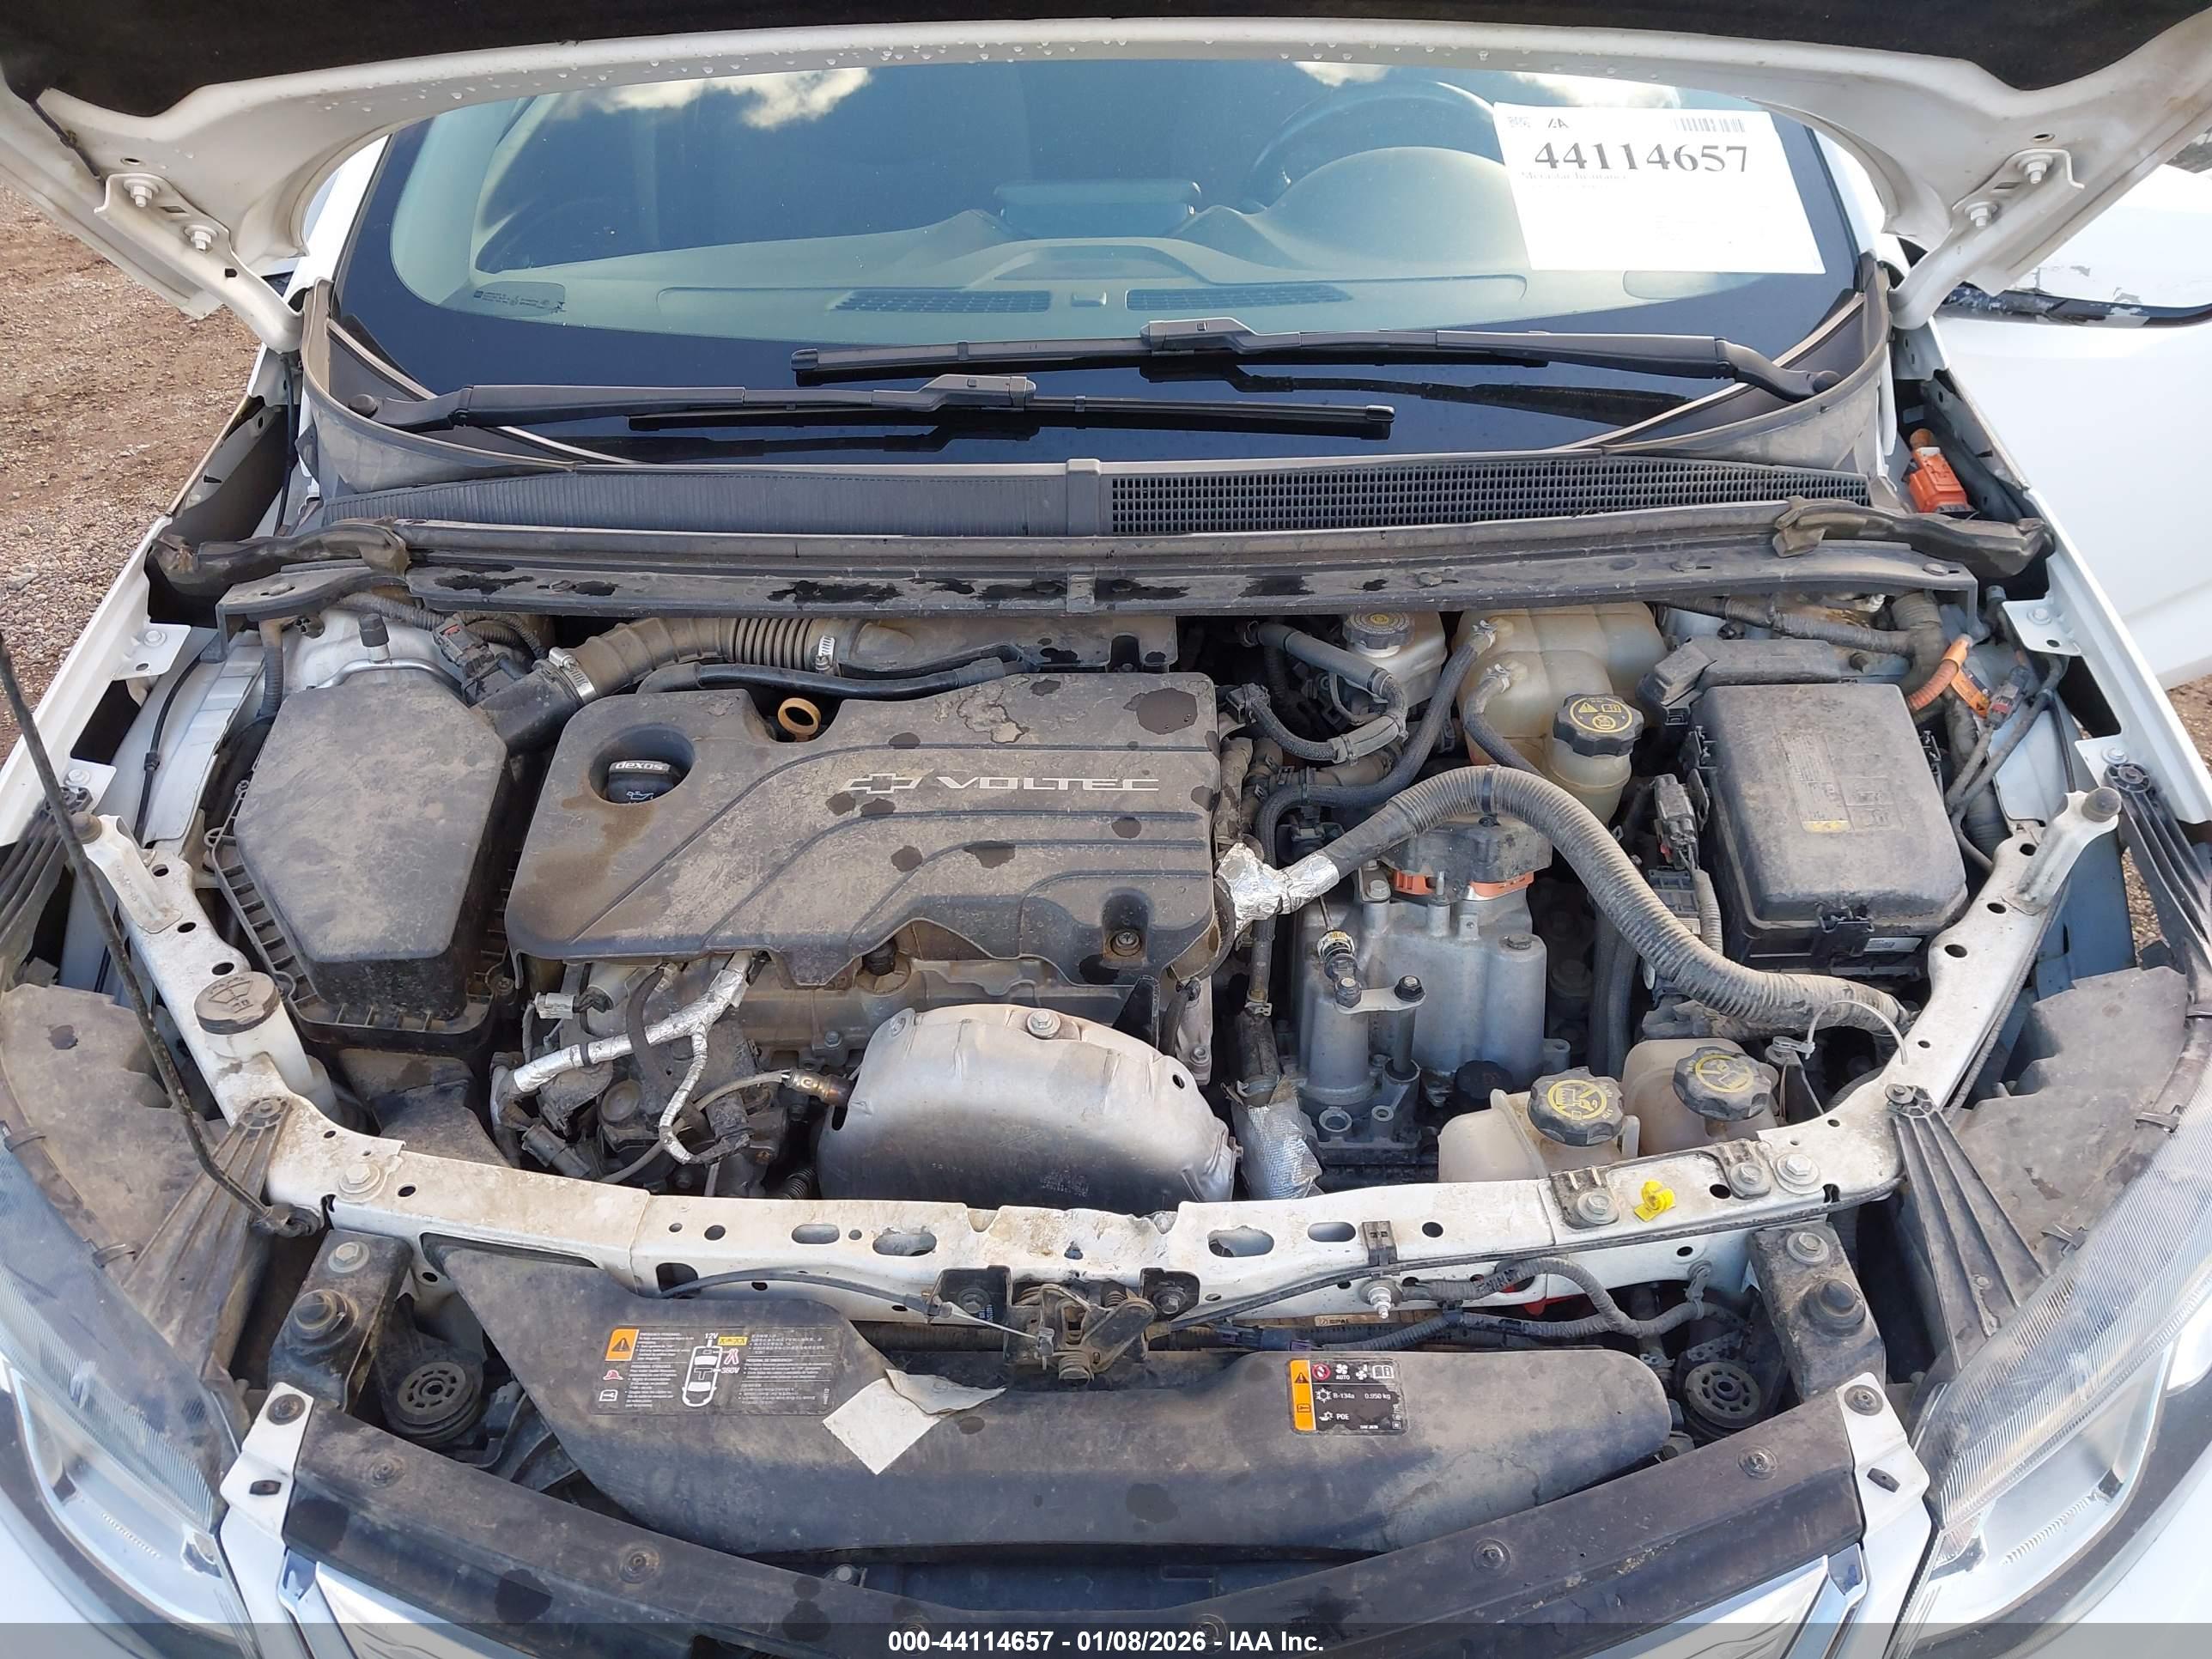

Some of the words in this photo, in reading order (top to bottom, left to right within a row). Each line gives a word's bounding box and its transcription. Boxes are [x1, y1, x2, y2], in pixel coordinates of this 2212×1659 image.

[1534, 142, 1747, 173] 44114657
[615, 762, 663, 770] dexos
[937, 775, 1159, 792] VOLTEC
